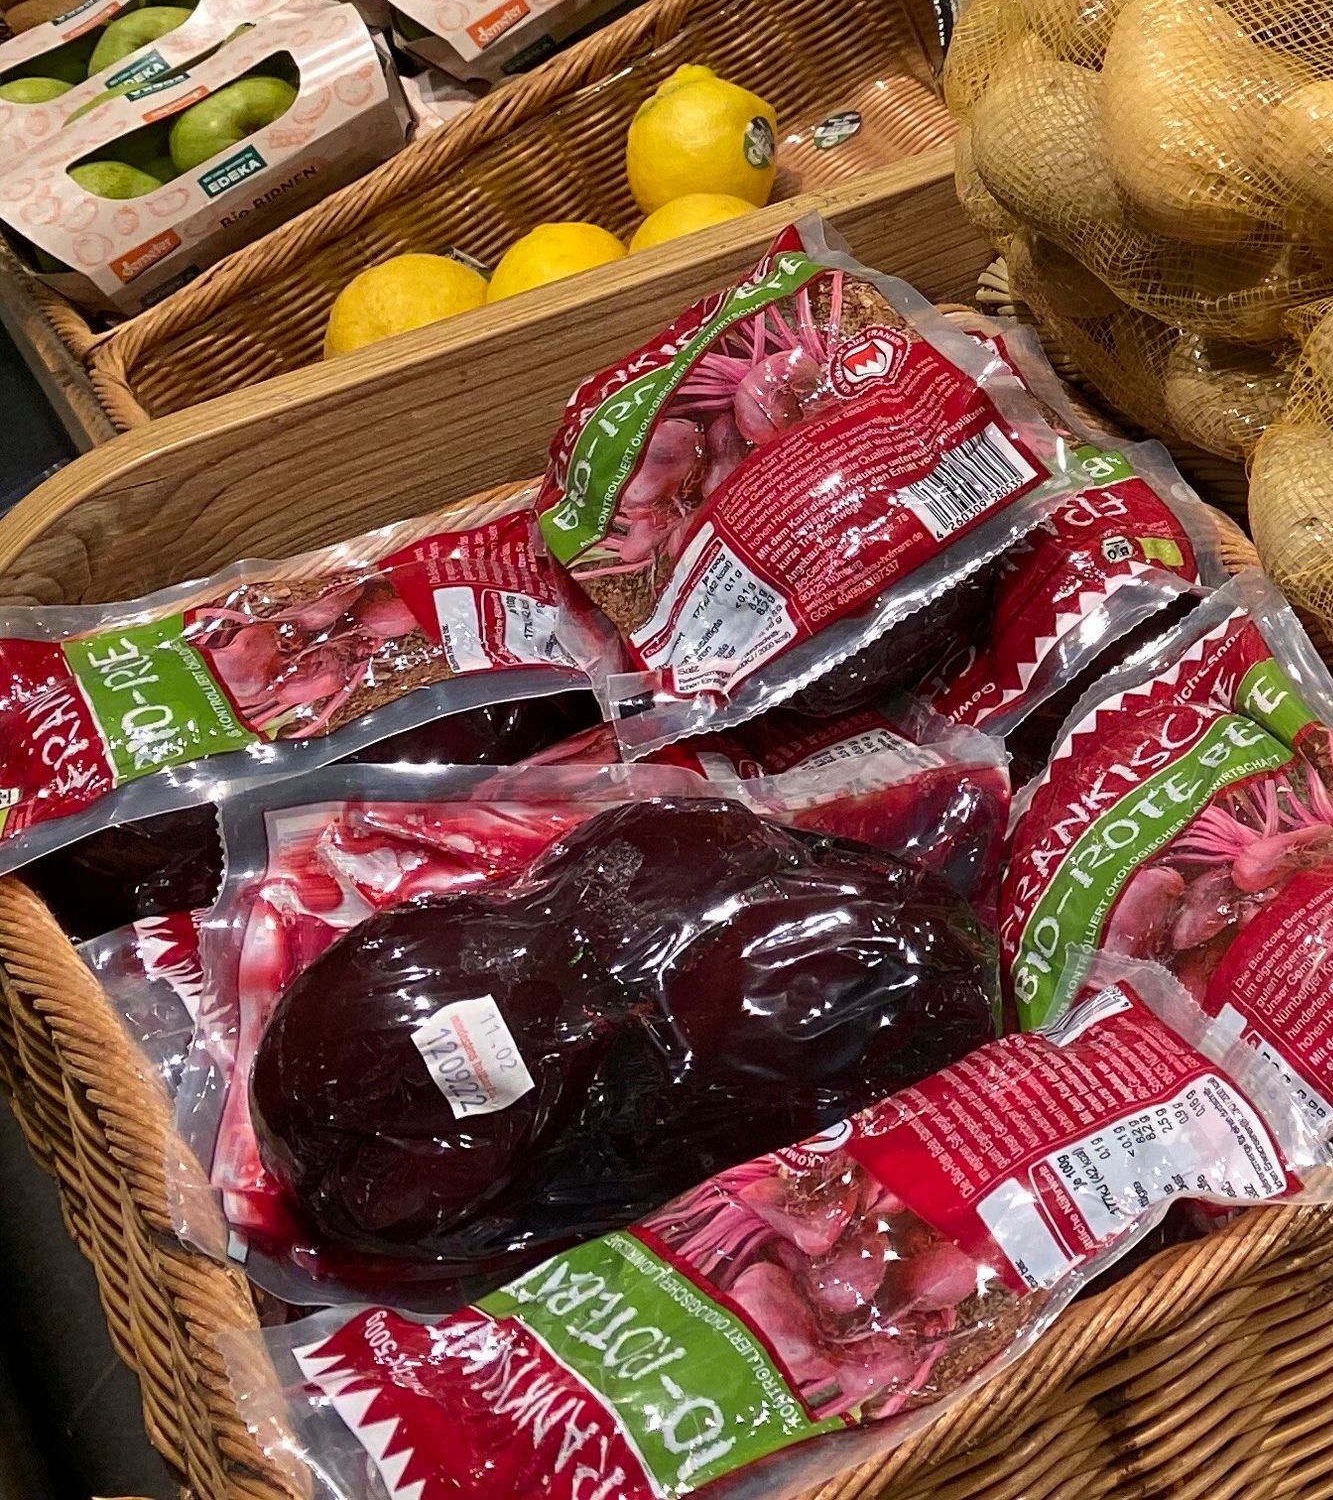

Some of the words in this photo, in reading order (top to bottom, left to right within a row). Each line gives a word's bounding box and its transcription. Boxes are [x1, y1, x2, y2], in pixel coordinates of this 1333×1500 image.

[208, 158, 261, 193] EDEKA
[948, 499, 988, 532] 260309
[990, 477, 1026, 504] 580535
[1105, 814, 1189, 898] ÖKOLOGISCHER
[1014, 770, 1202, 1005] BIO-ROTE
[1309, 1045, 1329, 1068] Mit
